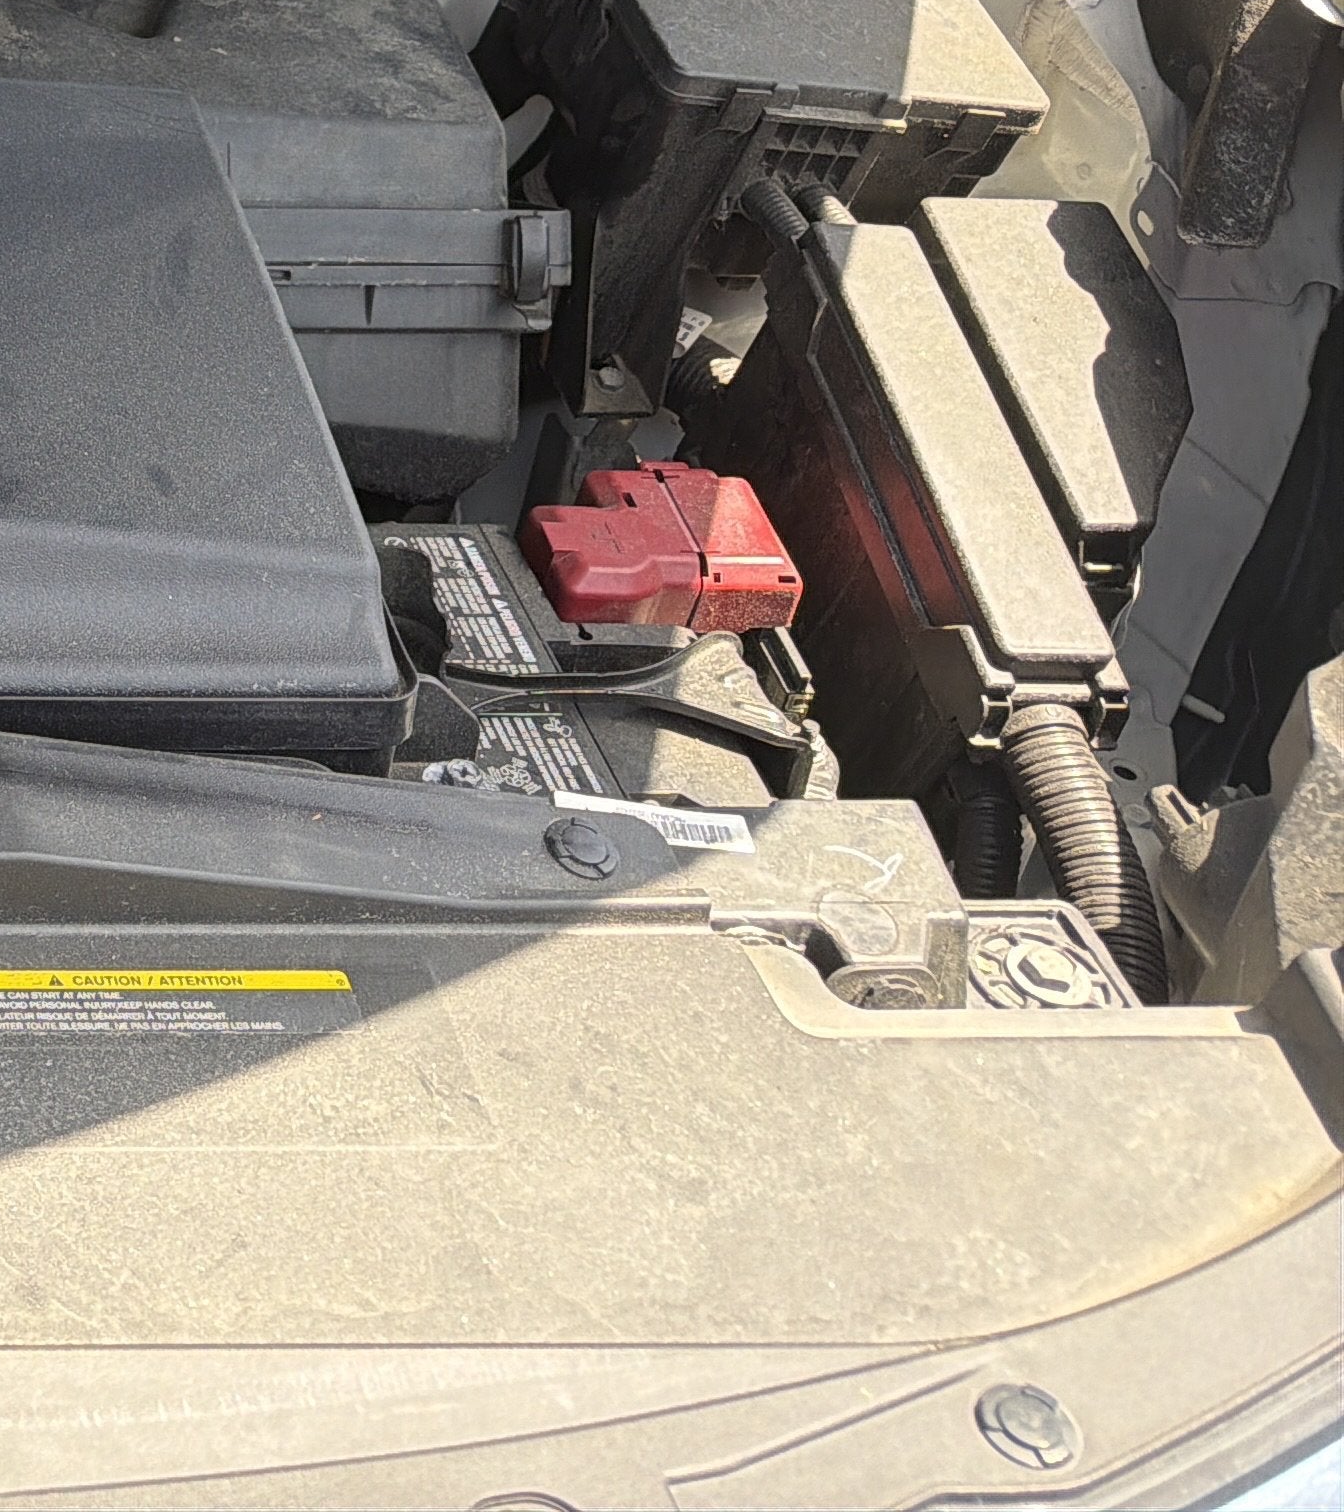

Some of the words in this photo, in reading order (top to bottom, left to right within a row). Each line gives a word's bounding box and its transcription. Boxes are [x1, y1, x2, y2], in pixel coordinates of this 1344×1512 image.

[72, 975, 142, 986] CAUTION
[147, 975, 154, 986] /
[159, 975, 244, 986] ATTENTION
[7, 992, 30, 1000] CAN
[31, 992, 60, 1000] START
[63, 992, 74, 1000] AT
[76, 992, 97, 1000] ANY
[30, 1001, 82, 1010] PERSONAL
[144, 1001, 180, 1010] HANDS
[76, 1012, 89, 1020] DE
[157, 1012, 182, 1020] TOUT
[26, 1022, 58, 1030] TOUTE
[131, 1022, 150, 1030] PAS
[168, 1022, 230, 1030] APPROCHER
